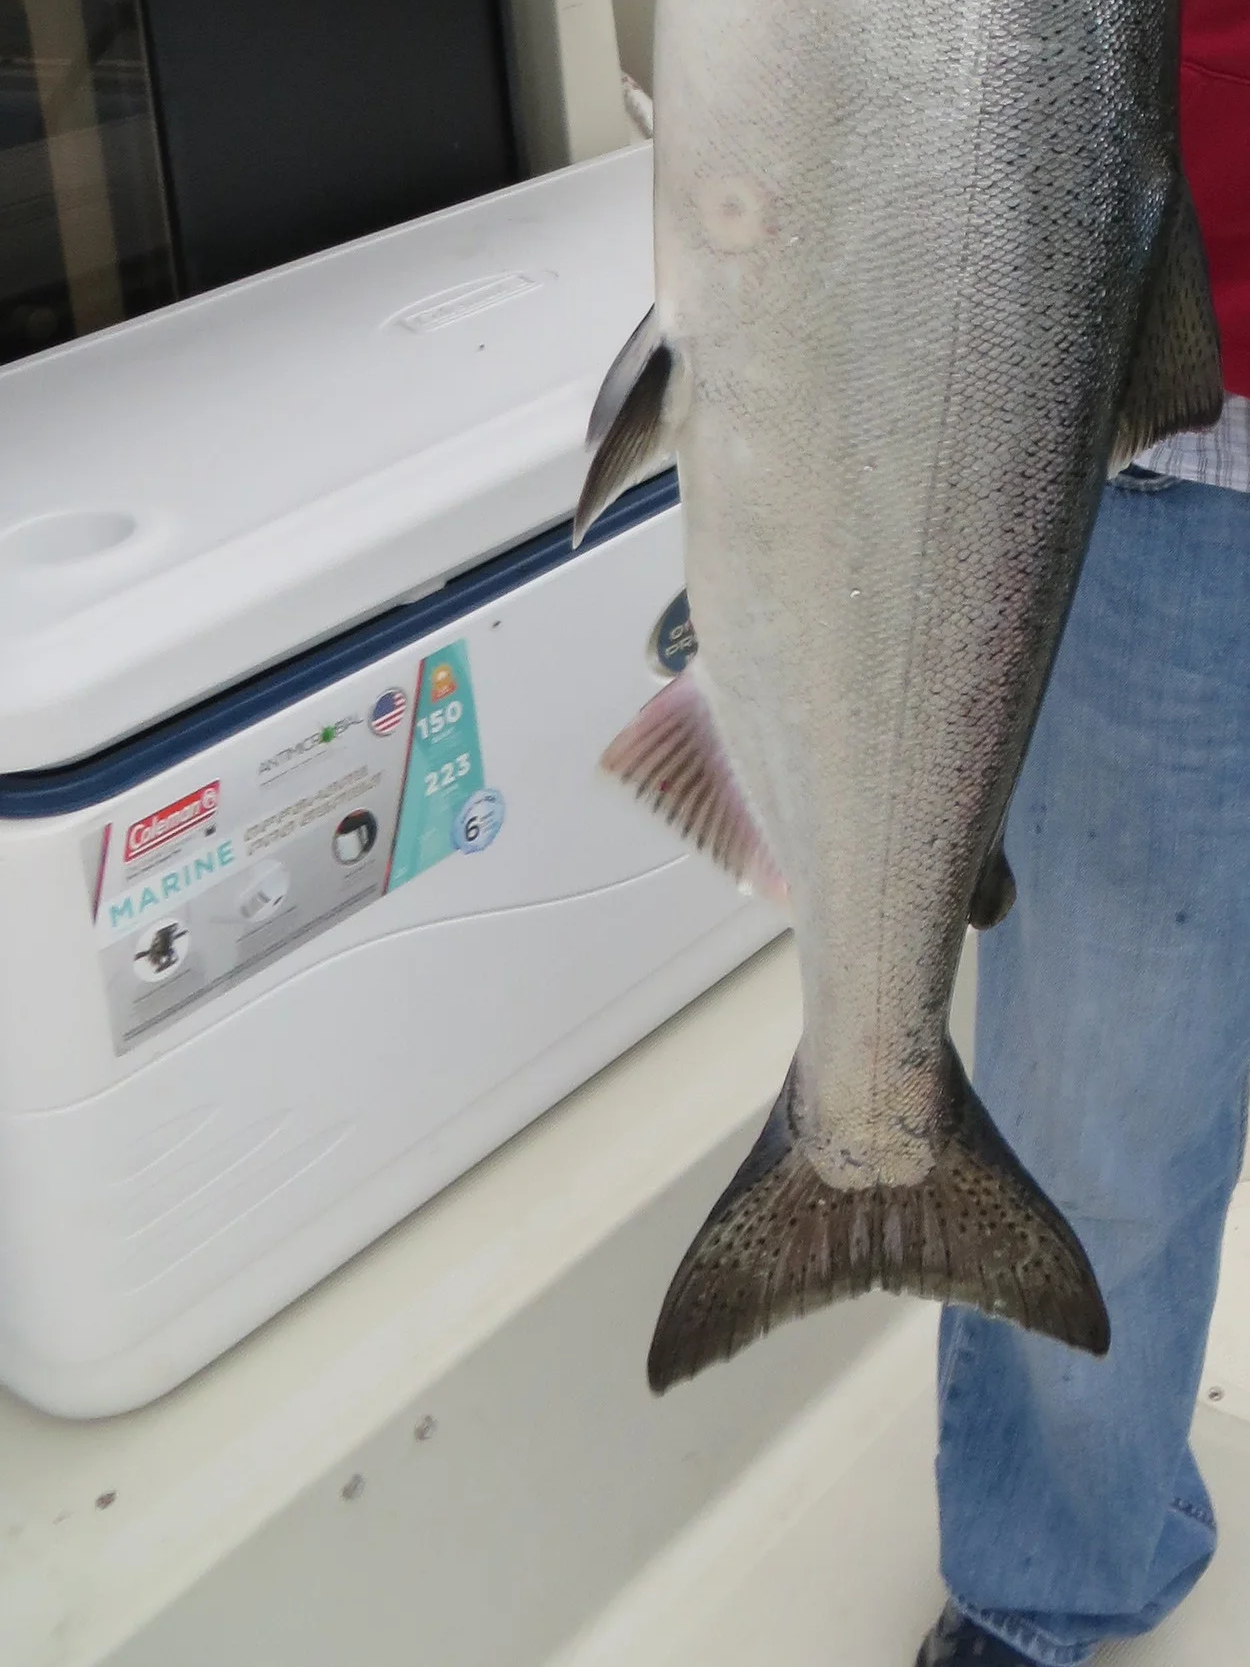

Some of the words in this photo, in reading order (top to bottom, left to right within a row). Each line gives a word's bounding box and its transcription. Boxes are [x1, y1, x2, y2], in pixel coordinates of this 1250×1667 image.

[416, 699, 463, 740] 150
[423, 752, 472, 798] 223
[129, 798, 202, 851] Coleman
[463, 815, 481, 843] 6
[109, 838, 236, 928] MARINE
